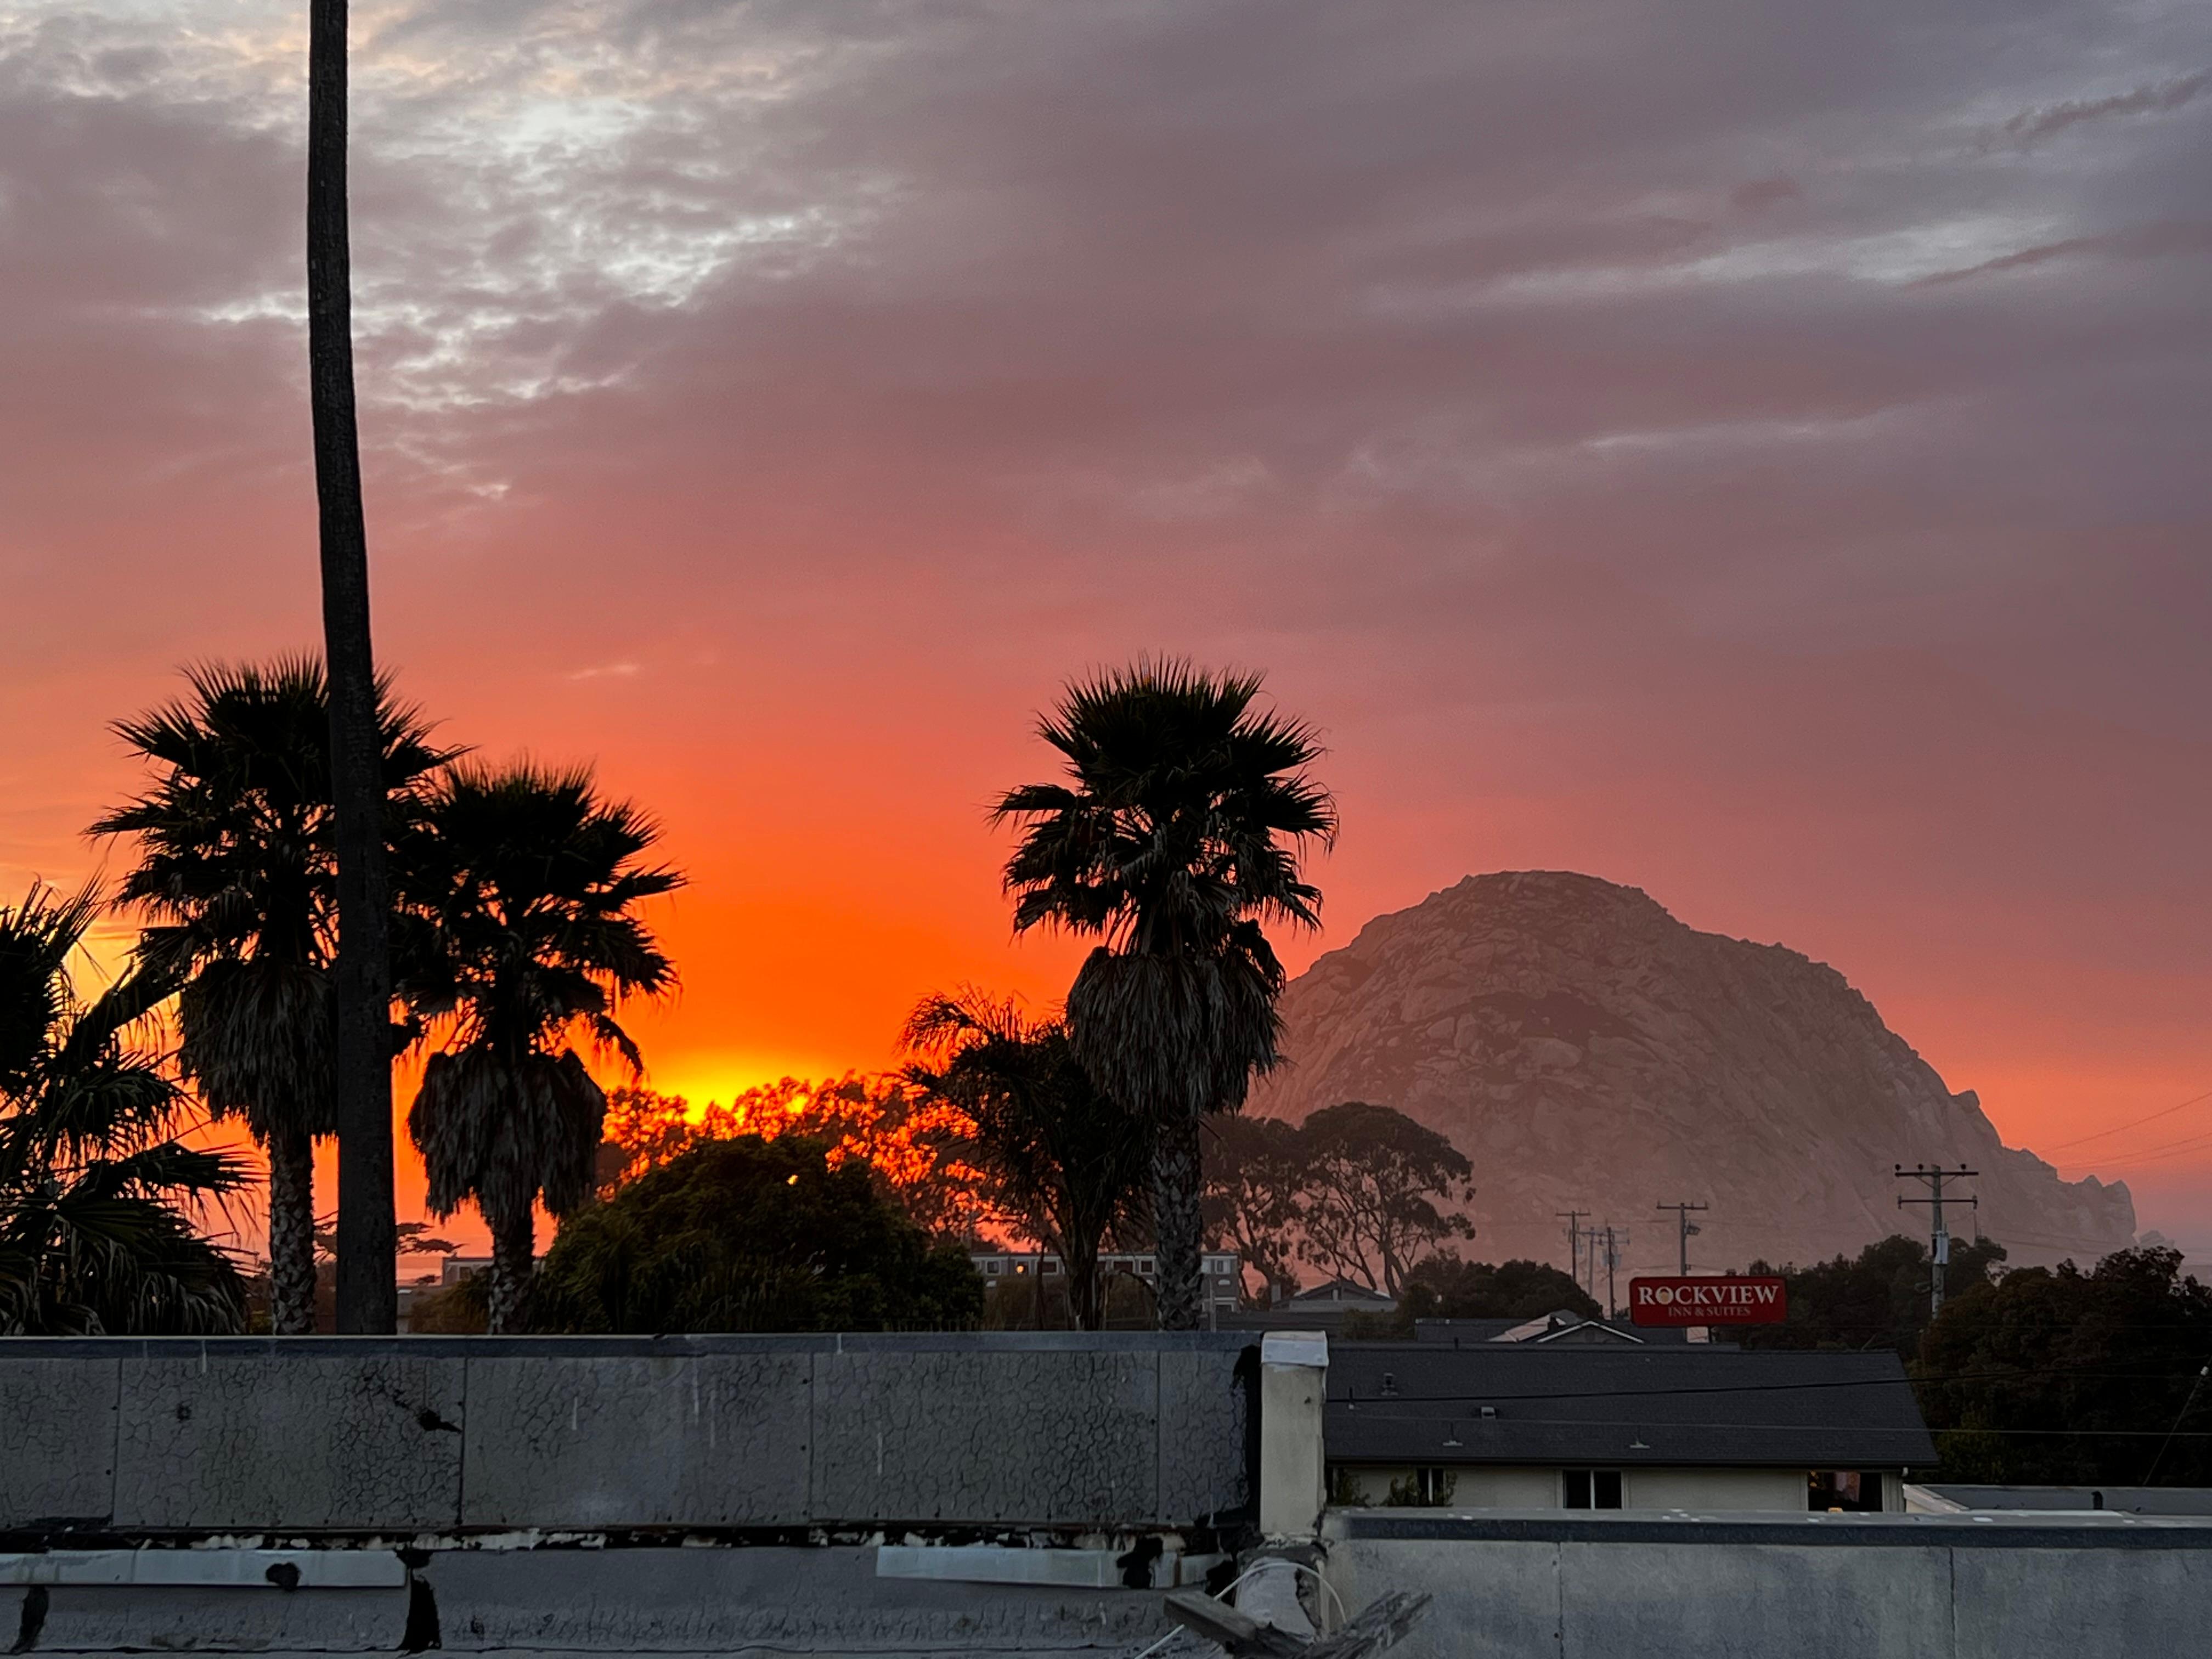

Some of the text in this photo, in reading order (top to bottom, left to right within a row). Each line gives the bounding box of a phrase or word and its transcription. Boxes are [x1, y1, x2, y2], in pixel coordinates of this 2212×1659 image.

[1638, 1285, 1779, 1305] ROCKVIEW
[1668, 1306, 1751, 1317] INN & SUITES
